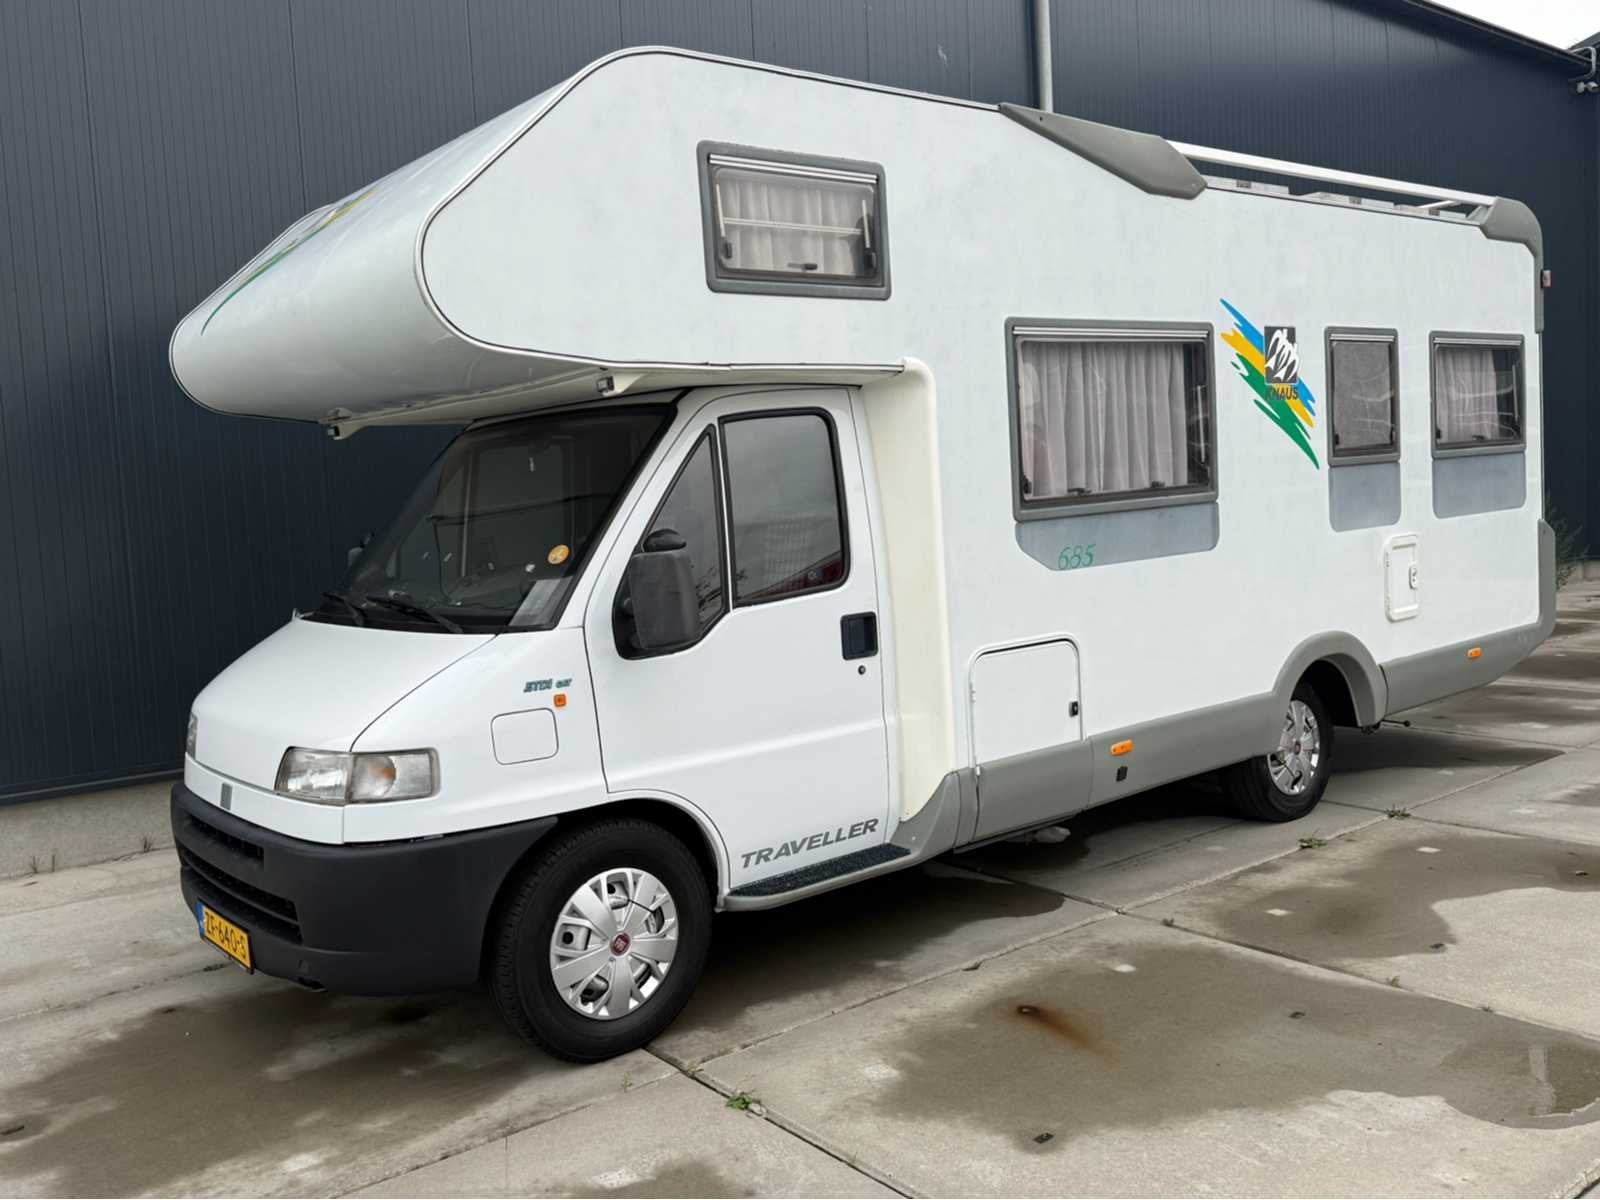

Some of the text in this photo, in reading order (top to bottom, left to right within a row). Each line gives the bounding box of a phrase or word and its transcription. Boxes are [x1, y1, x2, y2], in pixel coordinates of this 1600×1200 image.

[1265, 385, 1299, 401] KNAUS
[1058, 545, 1096, 570] 685
[741, 818, 879, 868] TRAVELLER
